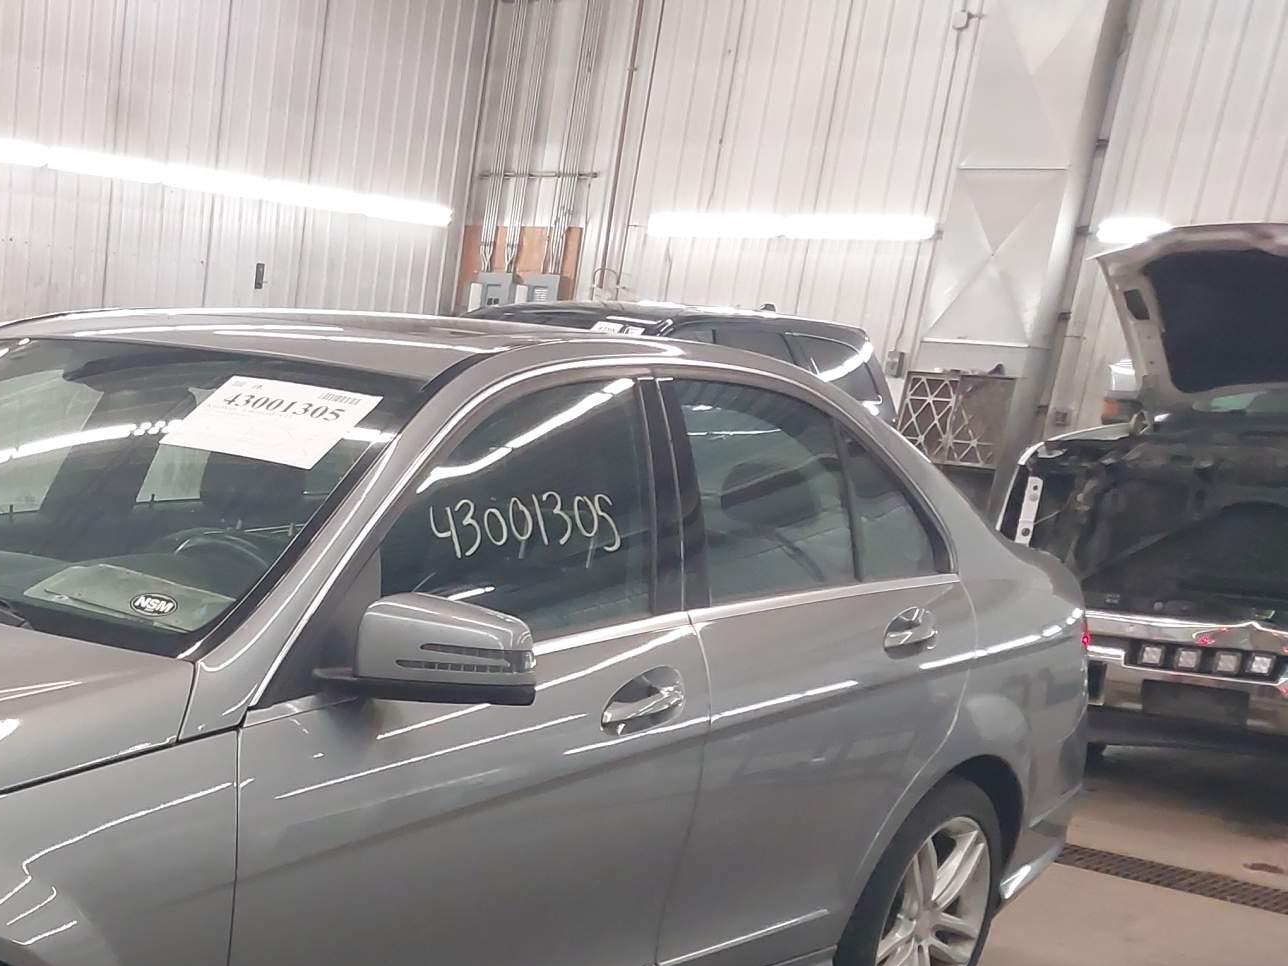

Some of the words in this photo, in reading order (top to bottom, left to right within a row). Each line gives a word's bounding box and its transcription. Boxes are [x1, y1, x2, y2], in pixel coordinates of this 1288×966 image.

[223, 391, 345, 422] 43001305
[429, 491, 622, 560] 43001305
[134, 595, 174, 613] NSM
